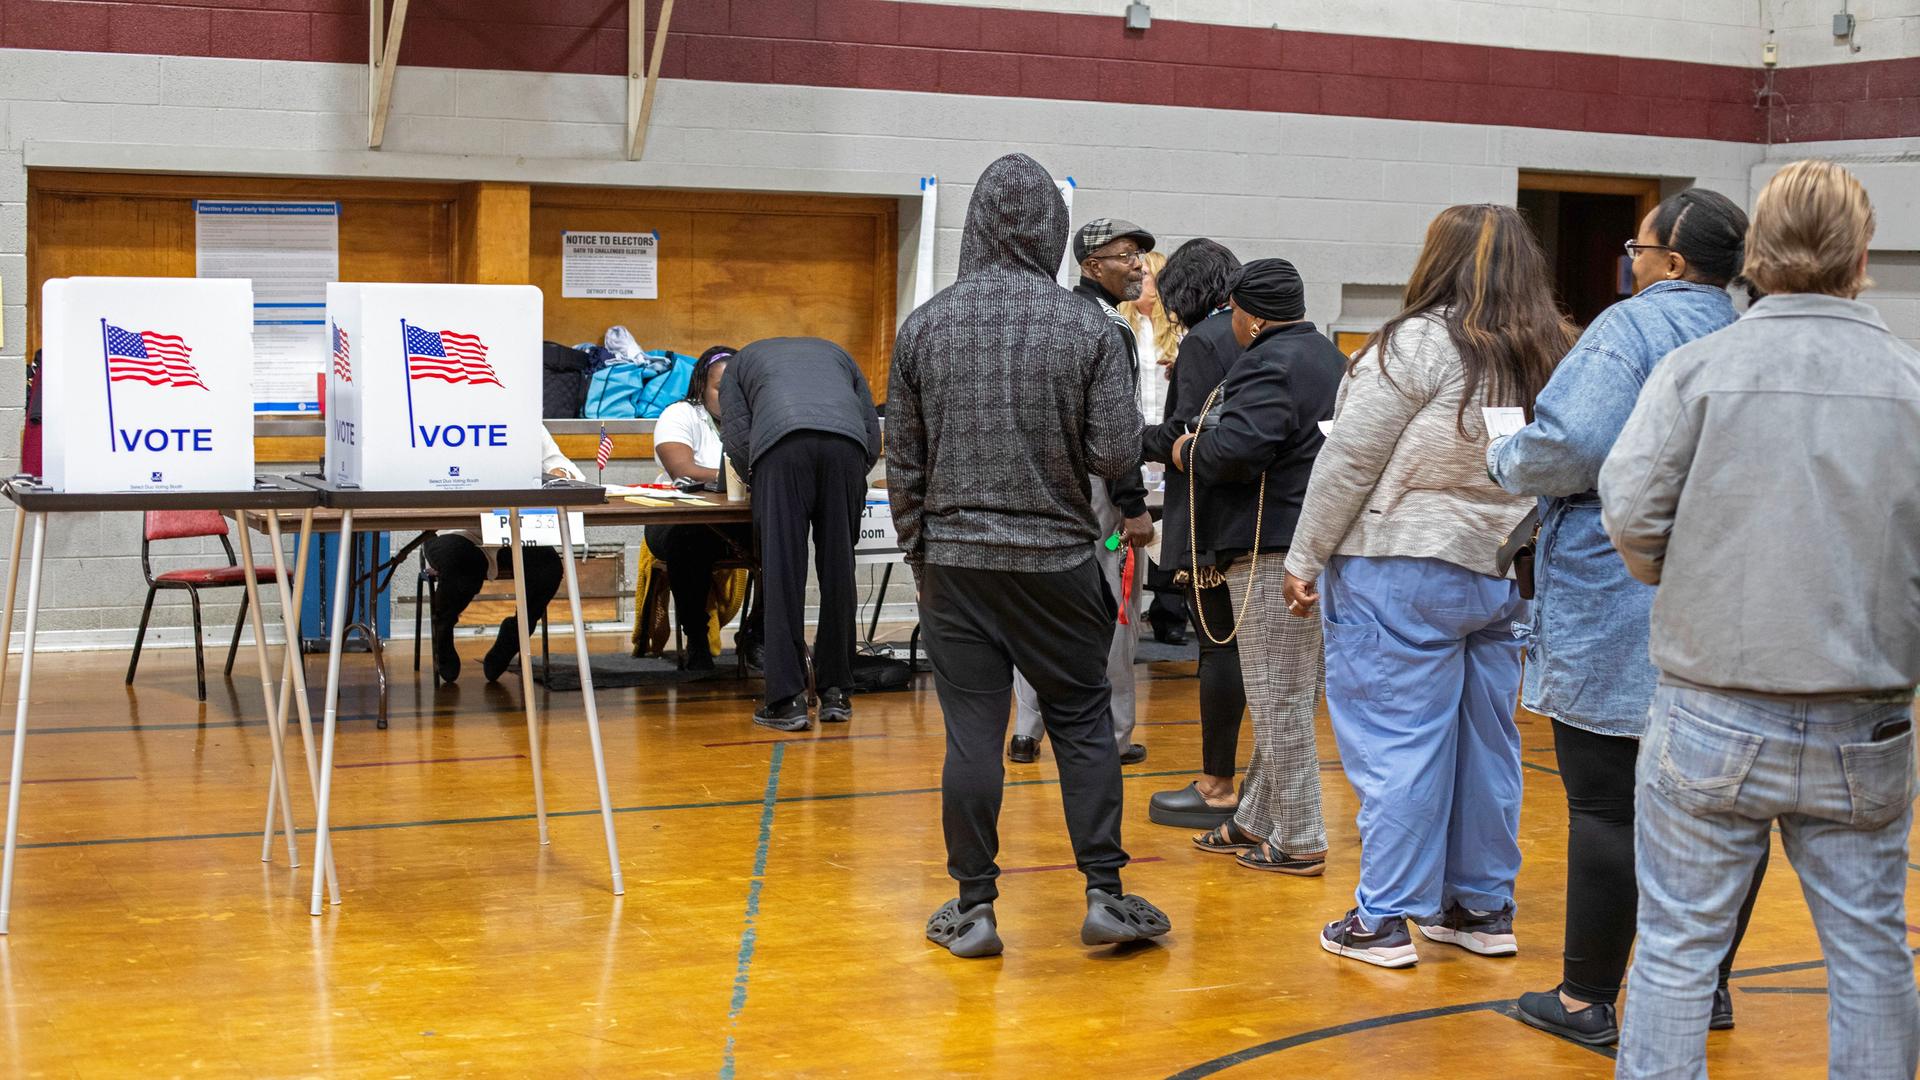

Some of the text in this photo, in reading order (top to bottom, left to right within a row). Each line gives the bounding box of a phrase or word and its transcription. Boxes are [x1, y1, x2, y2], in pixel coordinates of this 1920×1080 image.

[566, 235, 654, 246] NOTICE TO ELECTORS
[119, 428, 213, 452] VOTE
[336, 419, 355, 446] VOTE
[418, 424, 508, 448] VOTE
[500, 516, 524, 529] PT
[861, 529, 885, 539] oom
